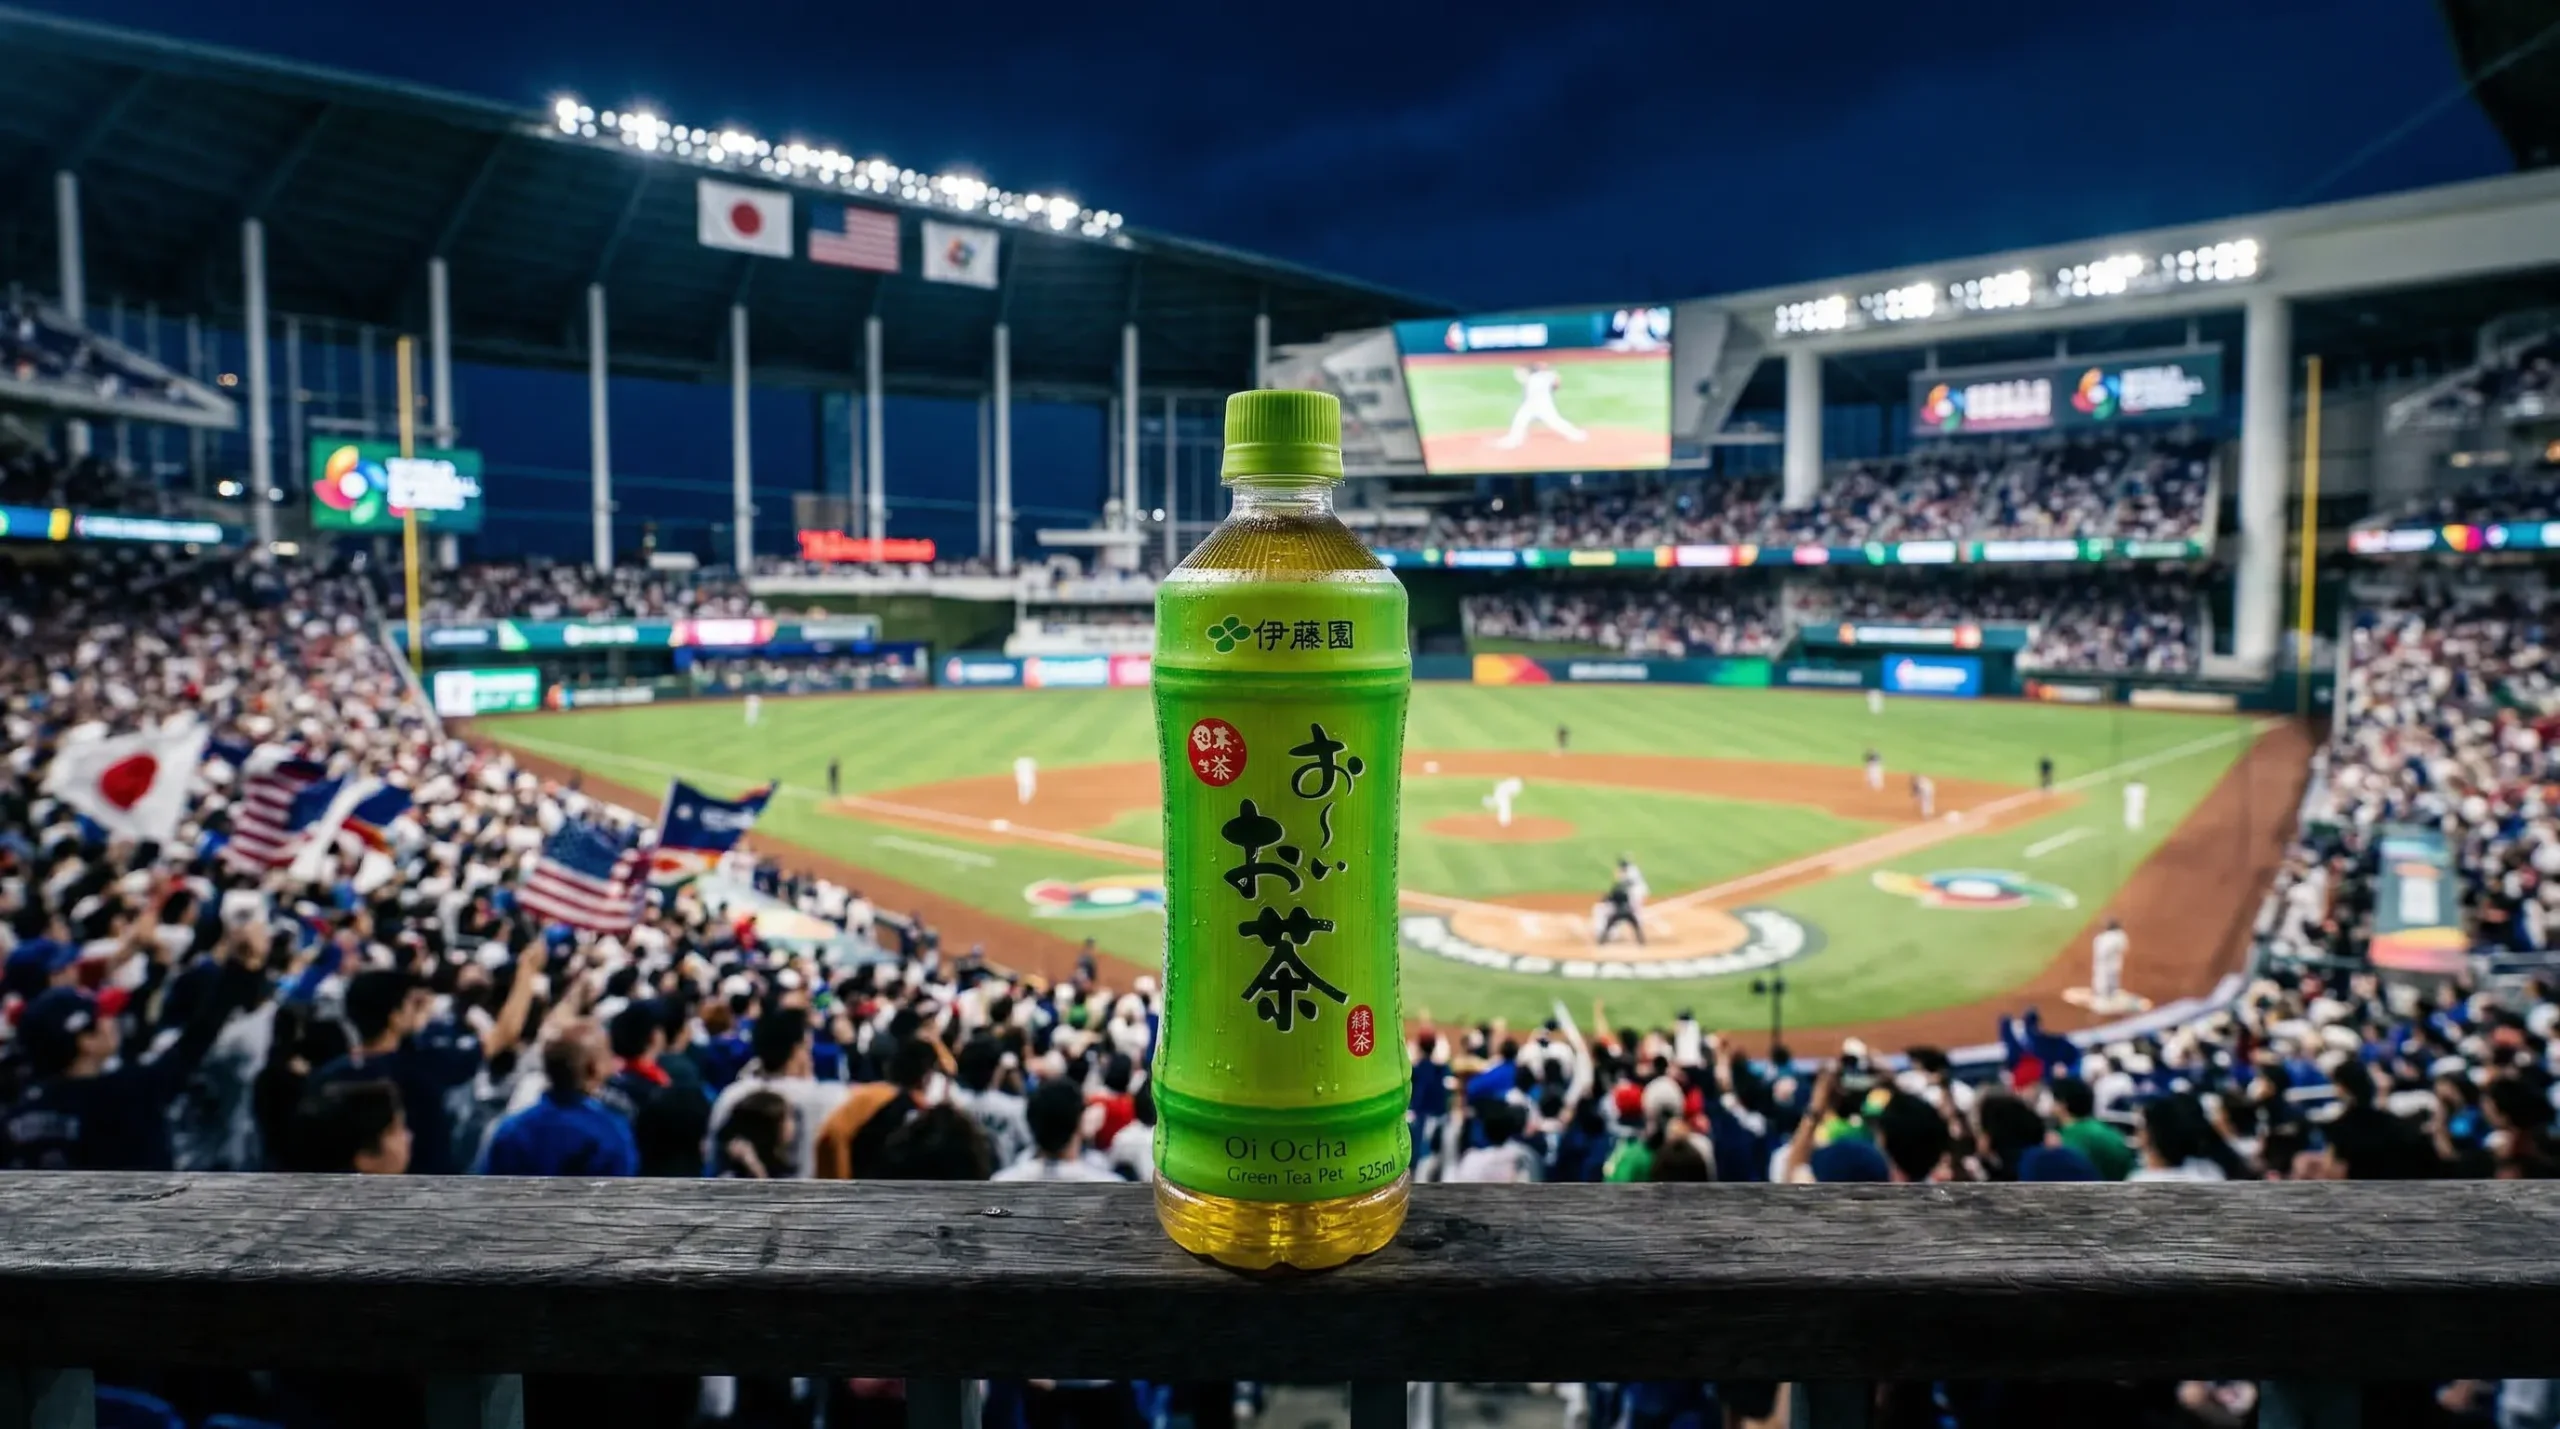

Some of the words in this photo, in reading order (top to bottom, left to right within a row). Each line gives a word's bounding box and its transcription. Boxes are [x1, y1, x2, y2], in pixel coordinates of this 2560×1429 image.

[1253, 618, 1354, 651] 伊藤園
[1225, 1136, 1258, 1161] Oi
[1270, 1136, 1348, 1163] Ocha
[1227, 1166, 1278, 1185] Green
[1284, 1169, 1312, 1185] Tea
[1318, 1167, 1345, 1184] Pet
[1357, 1154, 1396, 1184] 525ml
